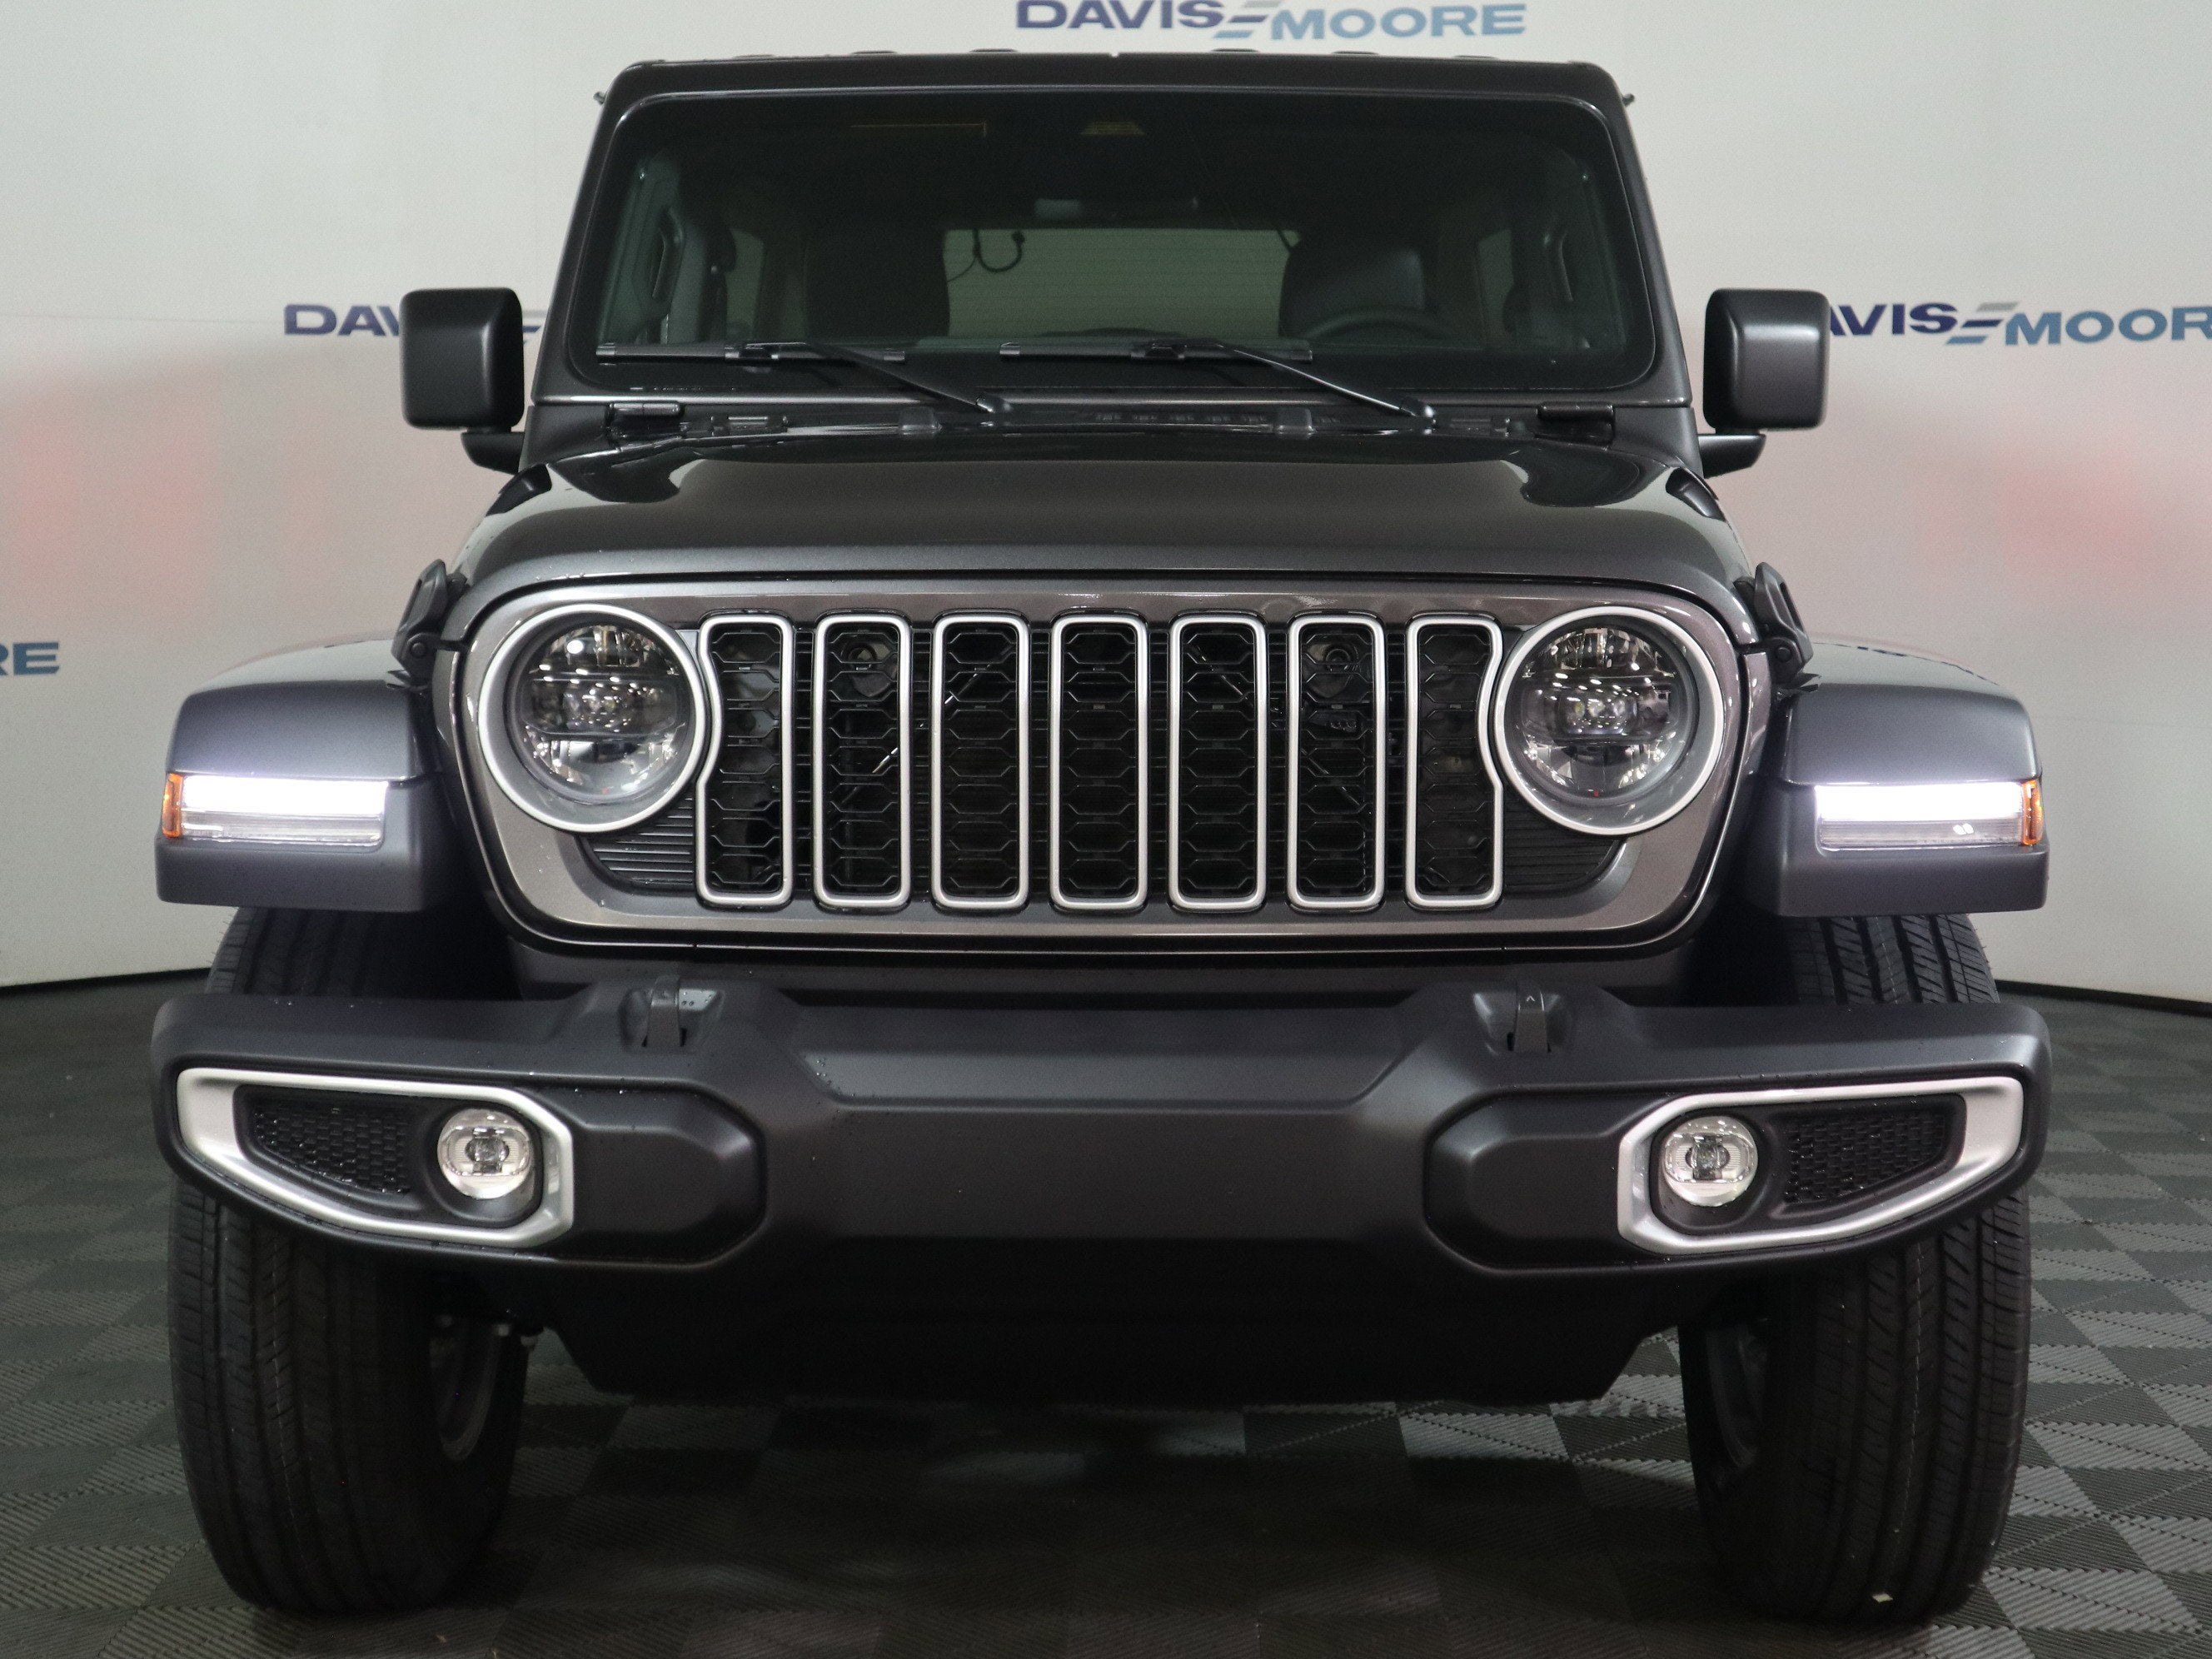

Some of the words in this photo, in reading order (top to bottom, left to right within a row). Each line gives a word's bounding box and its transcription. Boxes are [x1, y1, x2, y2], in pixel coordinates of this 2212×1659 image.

[1017, 0, 1224, 28] DAVIS
[1271, 3, 1527, 40] MOORE
[2004, 306, 2212, 346] MOOR
